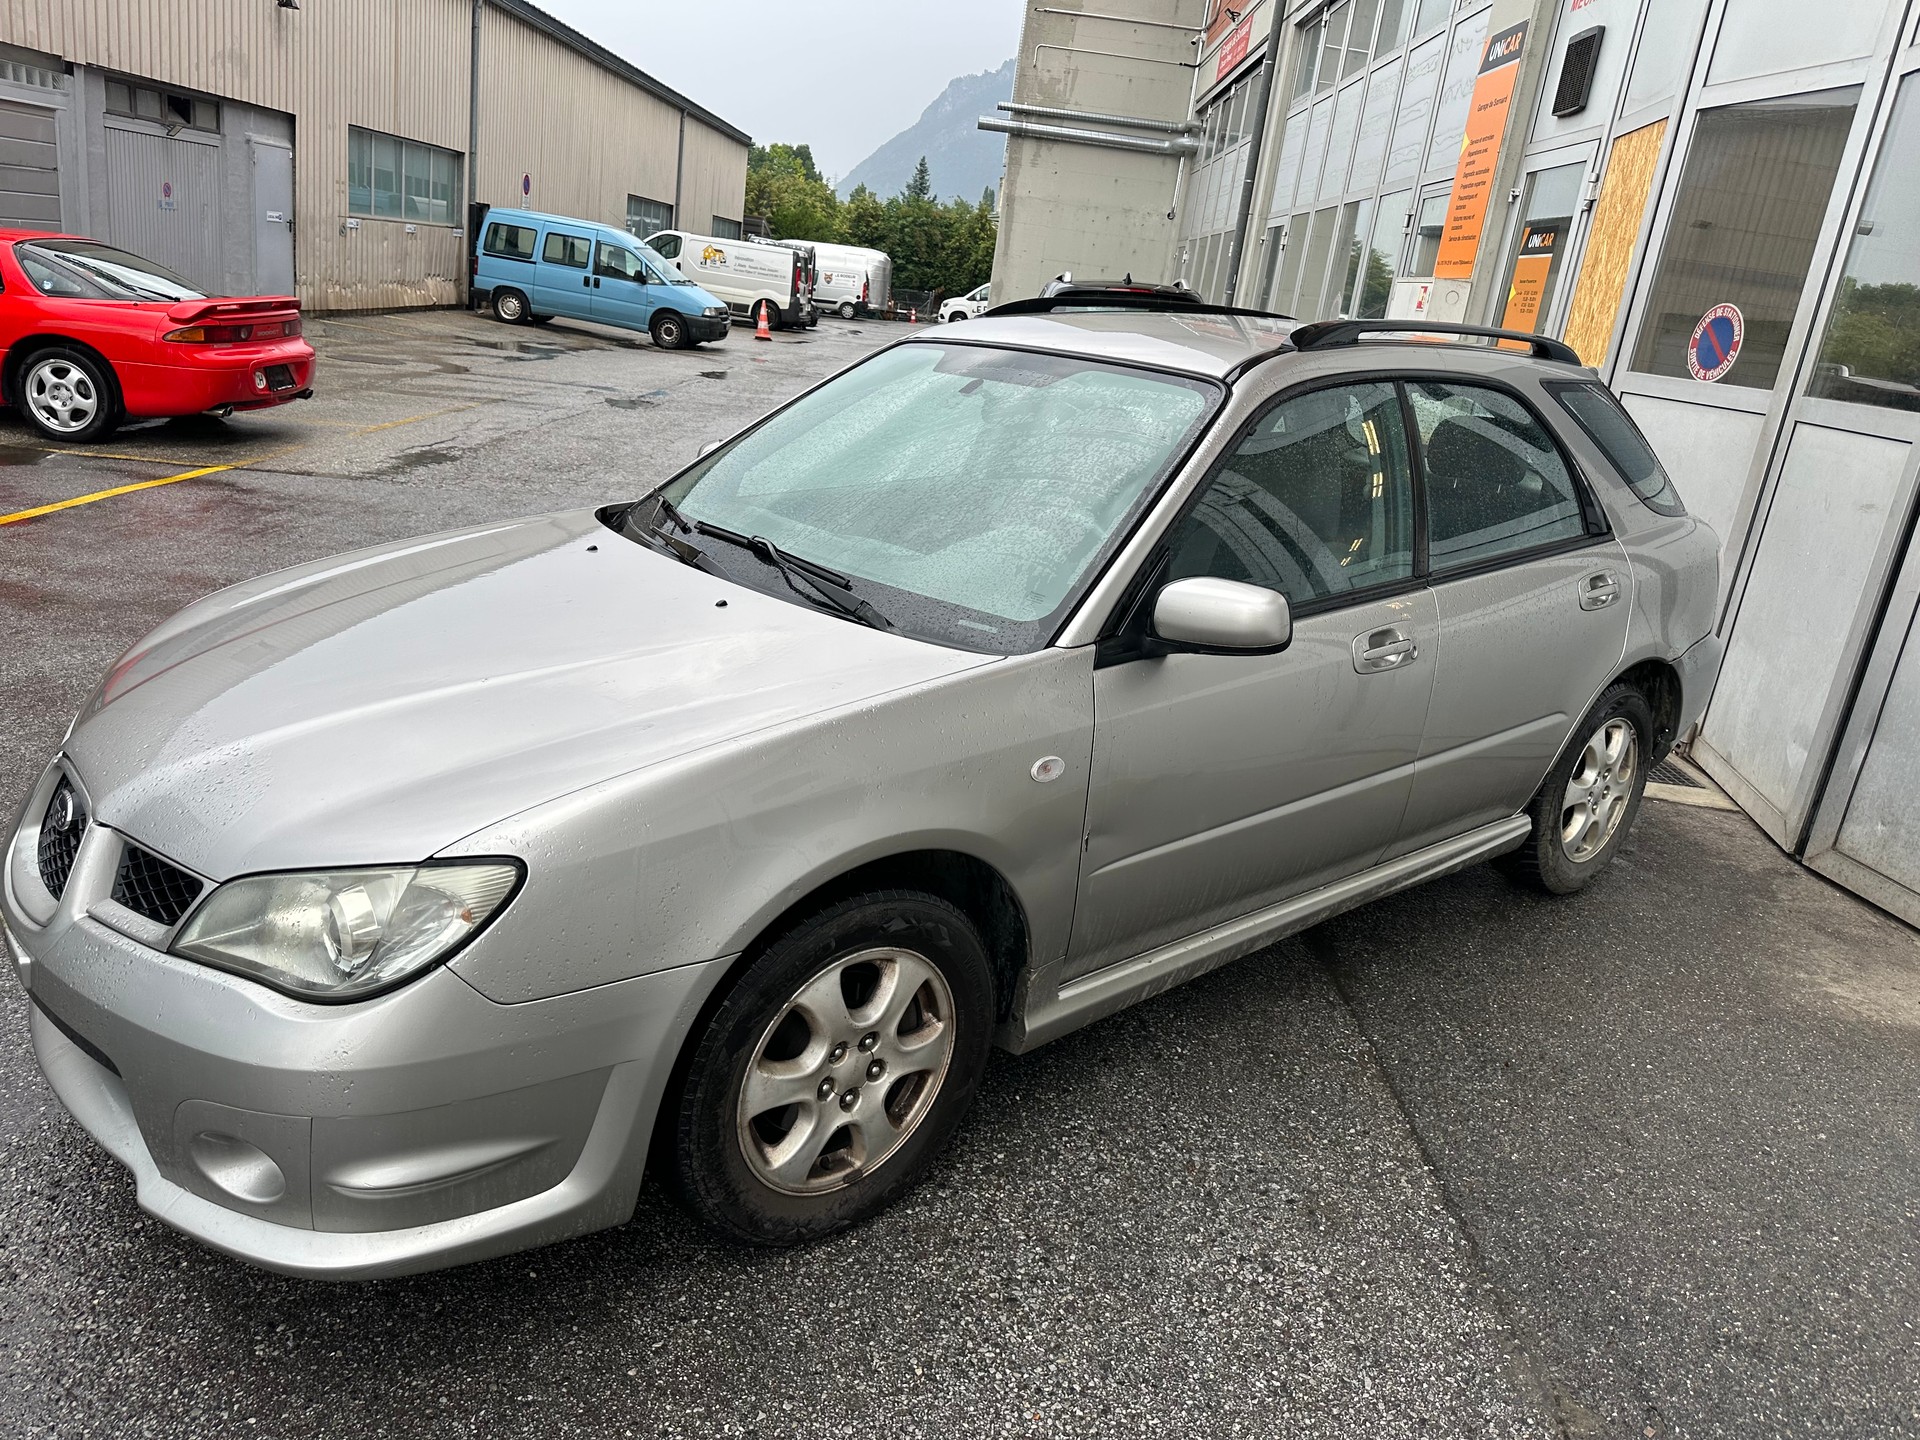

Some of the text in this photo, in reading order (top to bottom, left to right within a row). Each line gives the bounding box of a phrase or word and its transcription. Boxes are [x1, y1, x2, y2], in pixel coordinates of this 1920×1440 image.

[1477, 102, 1490, 112] Garage
[1716, 307, 1723, 317] DE
[1723, 306, 1741, 342] STATIONNER
[1690, 347, 1698, 374] SORTIE
[1697, 369, 1706, 379] DE
